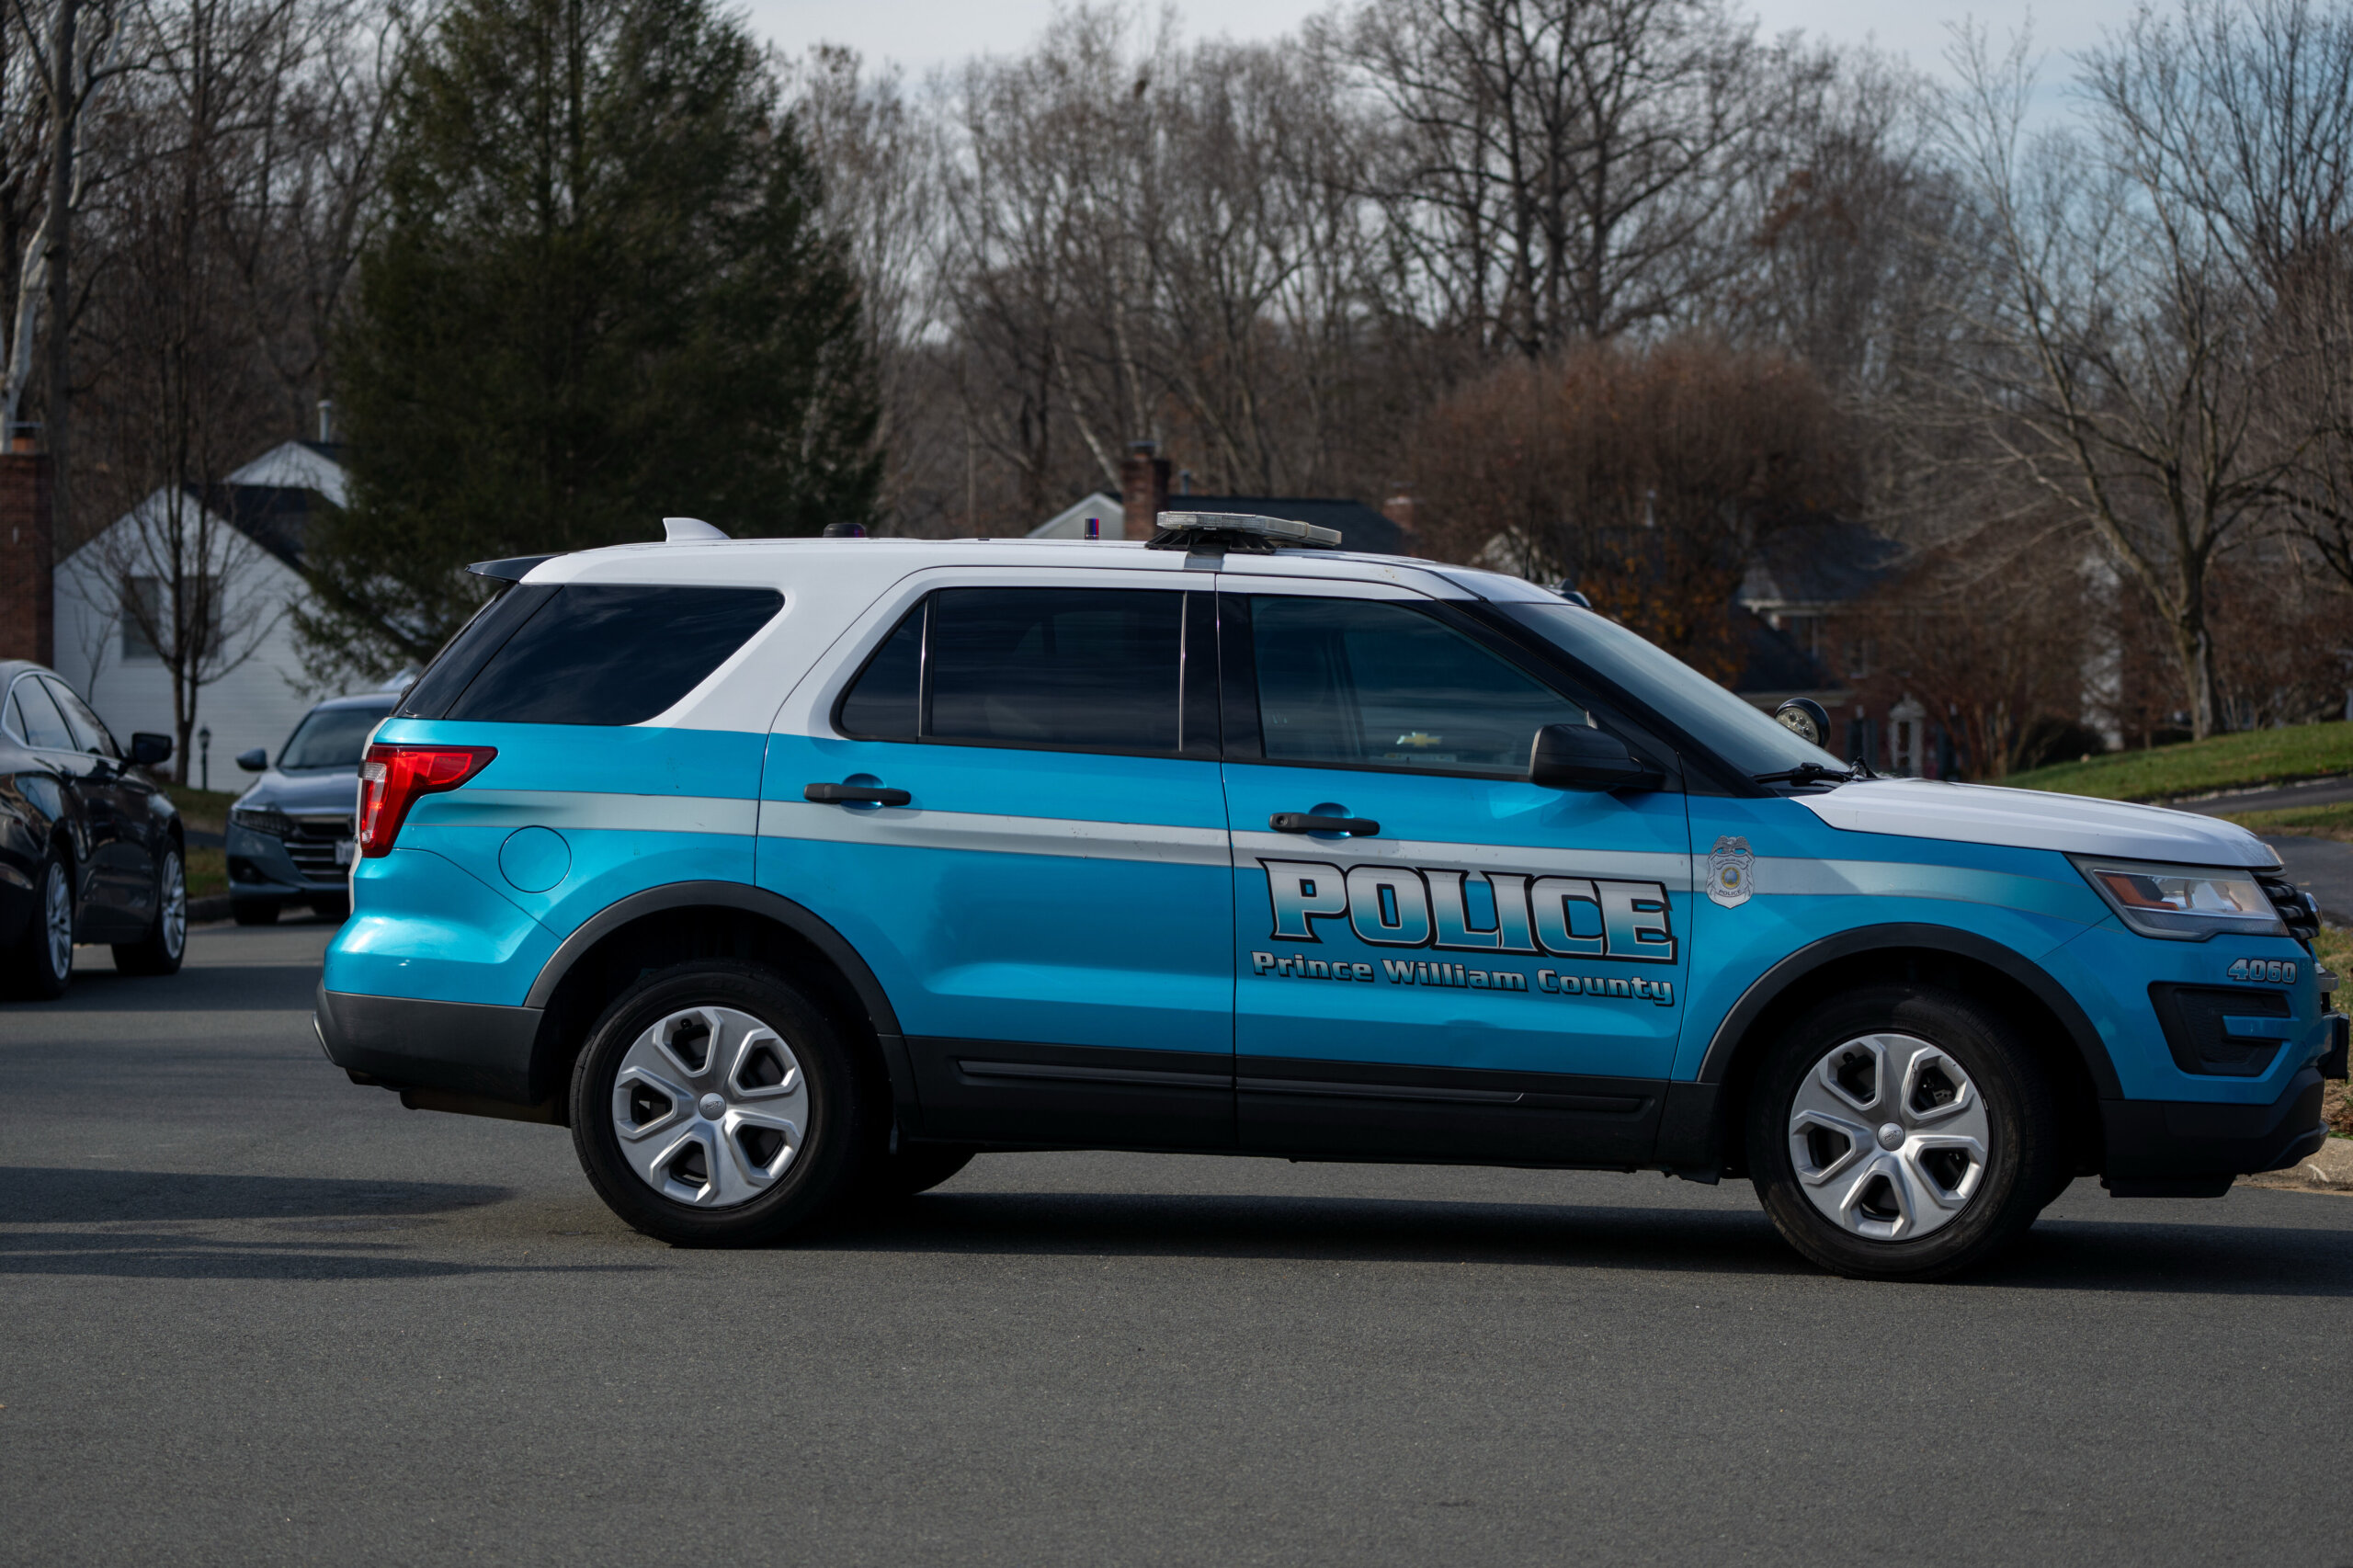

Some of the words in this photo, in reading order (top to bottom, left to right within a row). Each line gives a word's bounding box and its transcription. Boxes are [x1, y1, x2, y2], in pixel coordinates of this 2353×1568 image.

[1255, 857, 1678, 965] POLICE
[1251, 950, 1374, 983] Prince
[1381, 959, 1529, 993] William
[1537, 969, 1675, 1007] County
[2227, 959, 2296, 984] 4060
